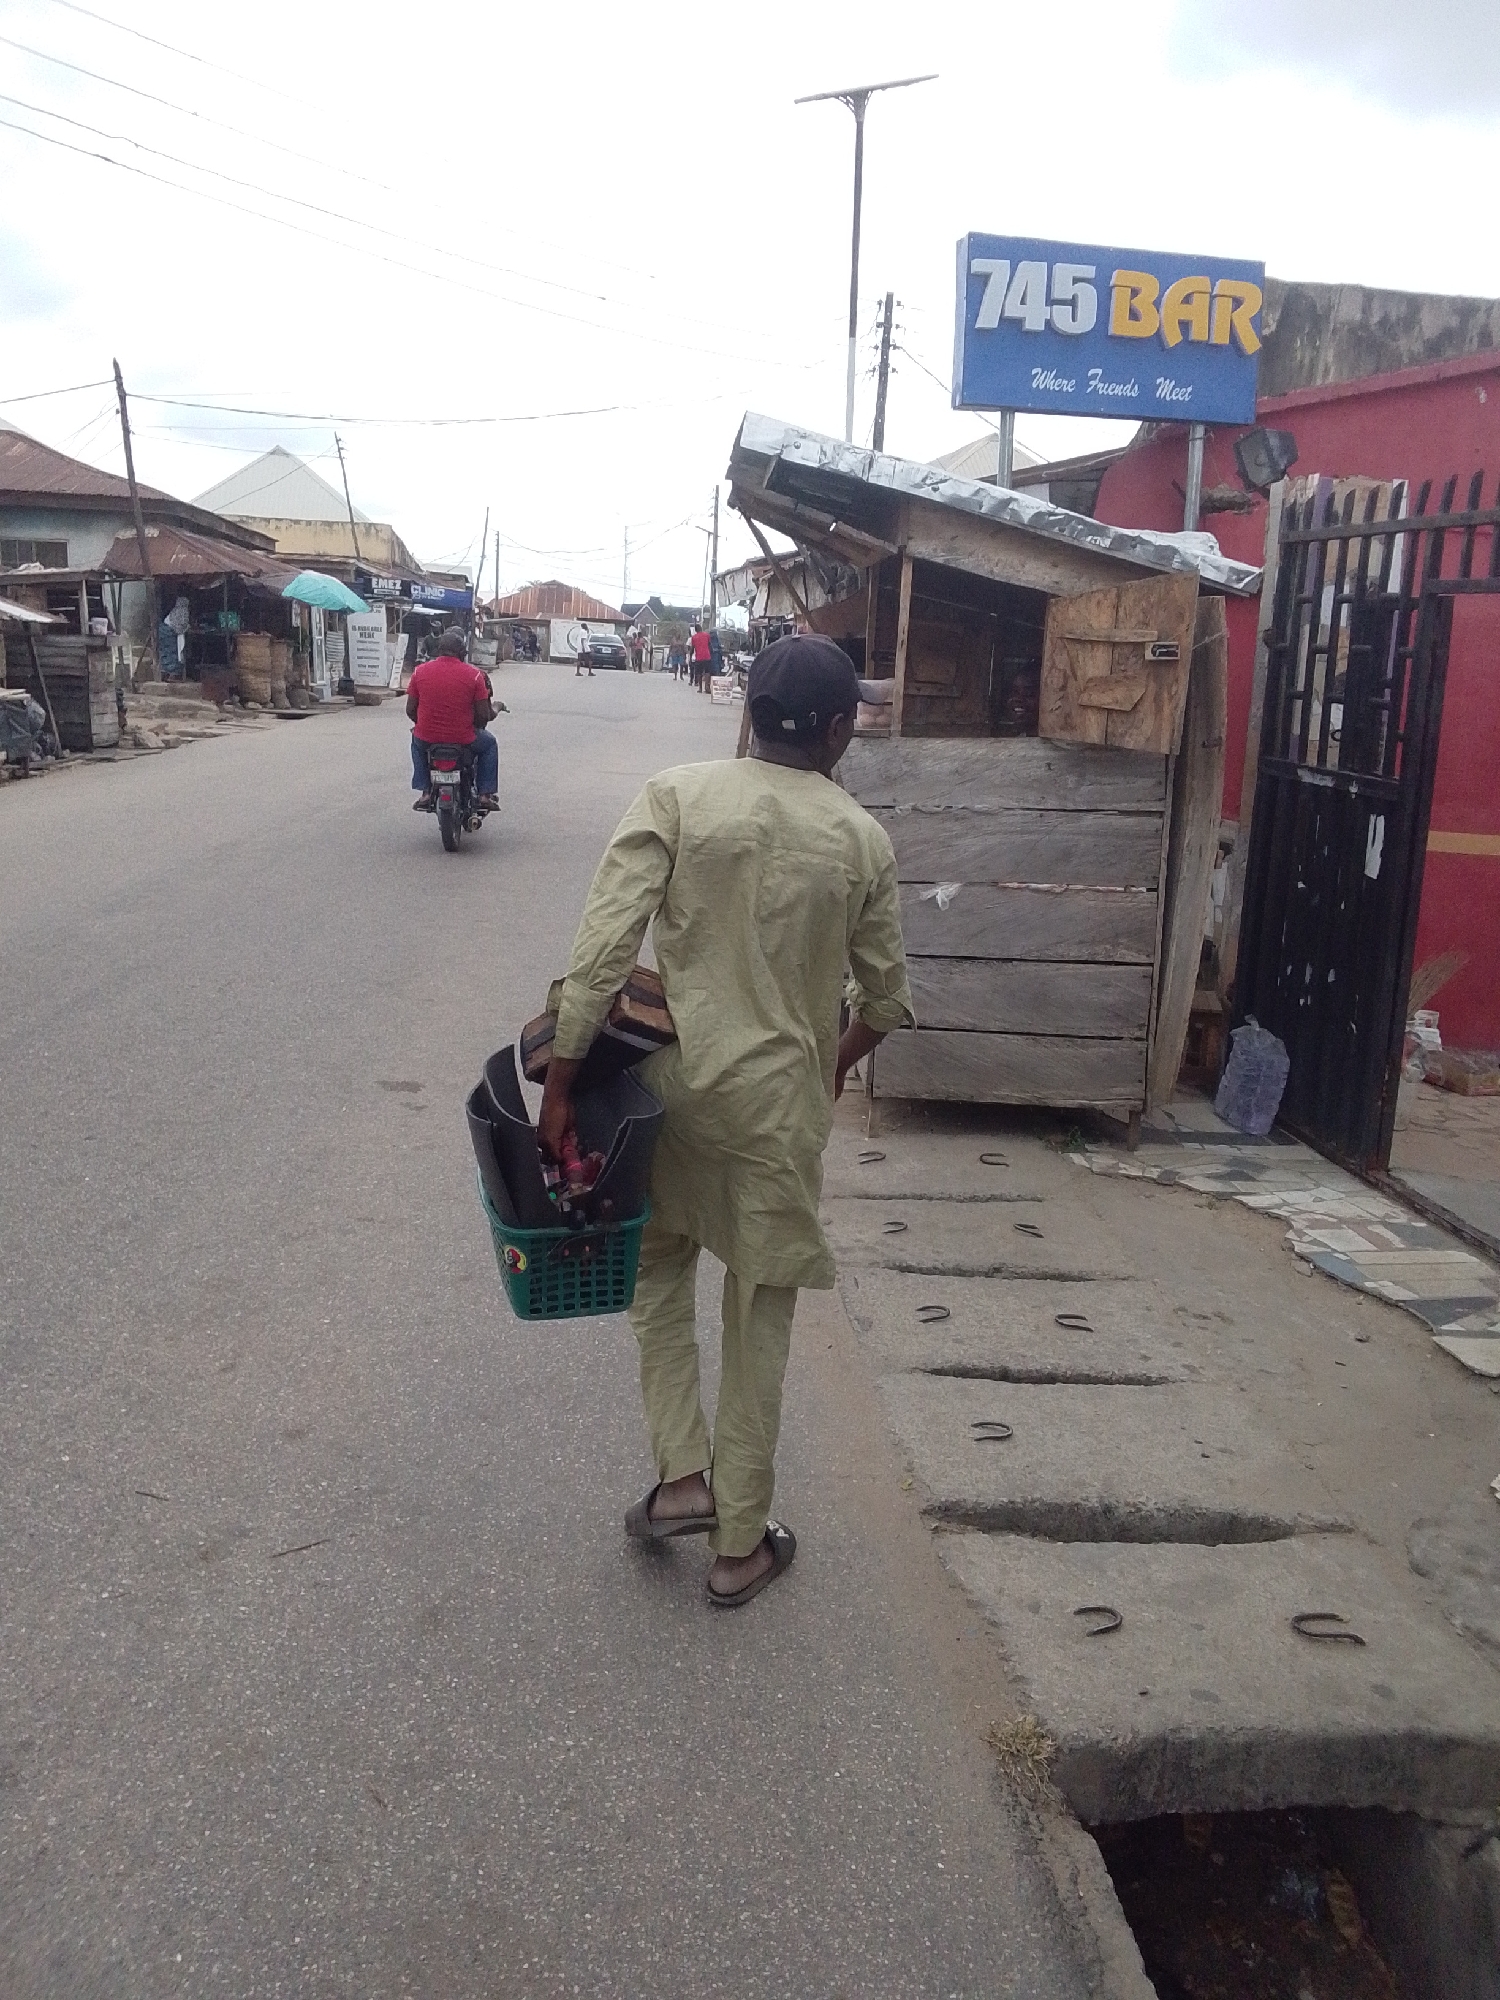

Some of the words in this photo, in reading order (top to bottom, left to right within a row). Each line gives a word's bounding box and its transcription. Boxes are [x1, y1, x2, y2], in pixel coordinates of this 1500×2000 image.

[970, 258, 1097, 336] 745
[1108, 269, 1263, 355] BAR
[1031, 367, 1076, 393] Where
[1085, 368, 1140, 397] Friends
[1155, 376, 1193, 402] Meet
[371, 577, 402, 589] EMEZ
[411, 584, 445, 597] CLINIC
